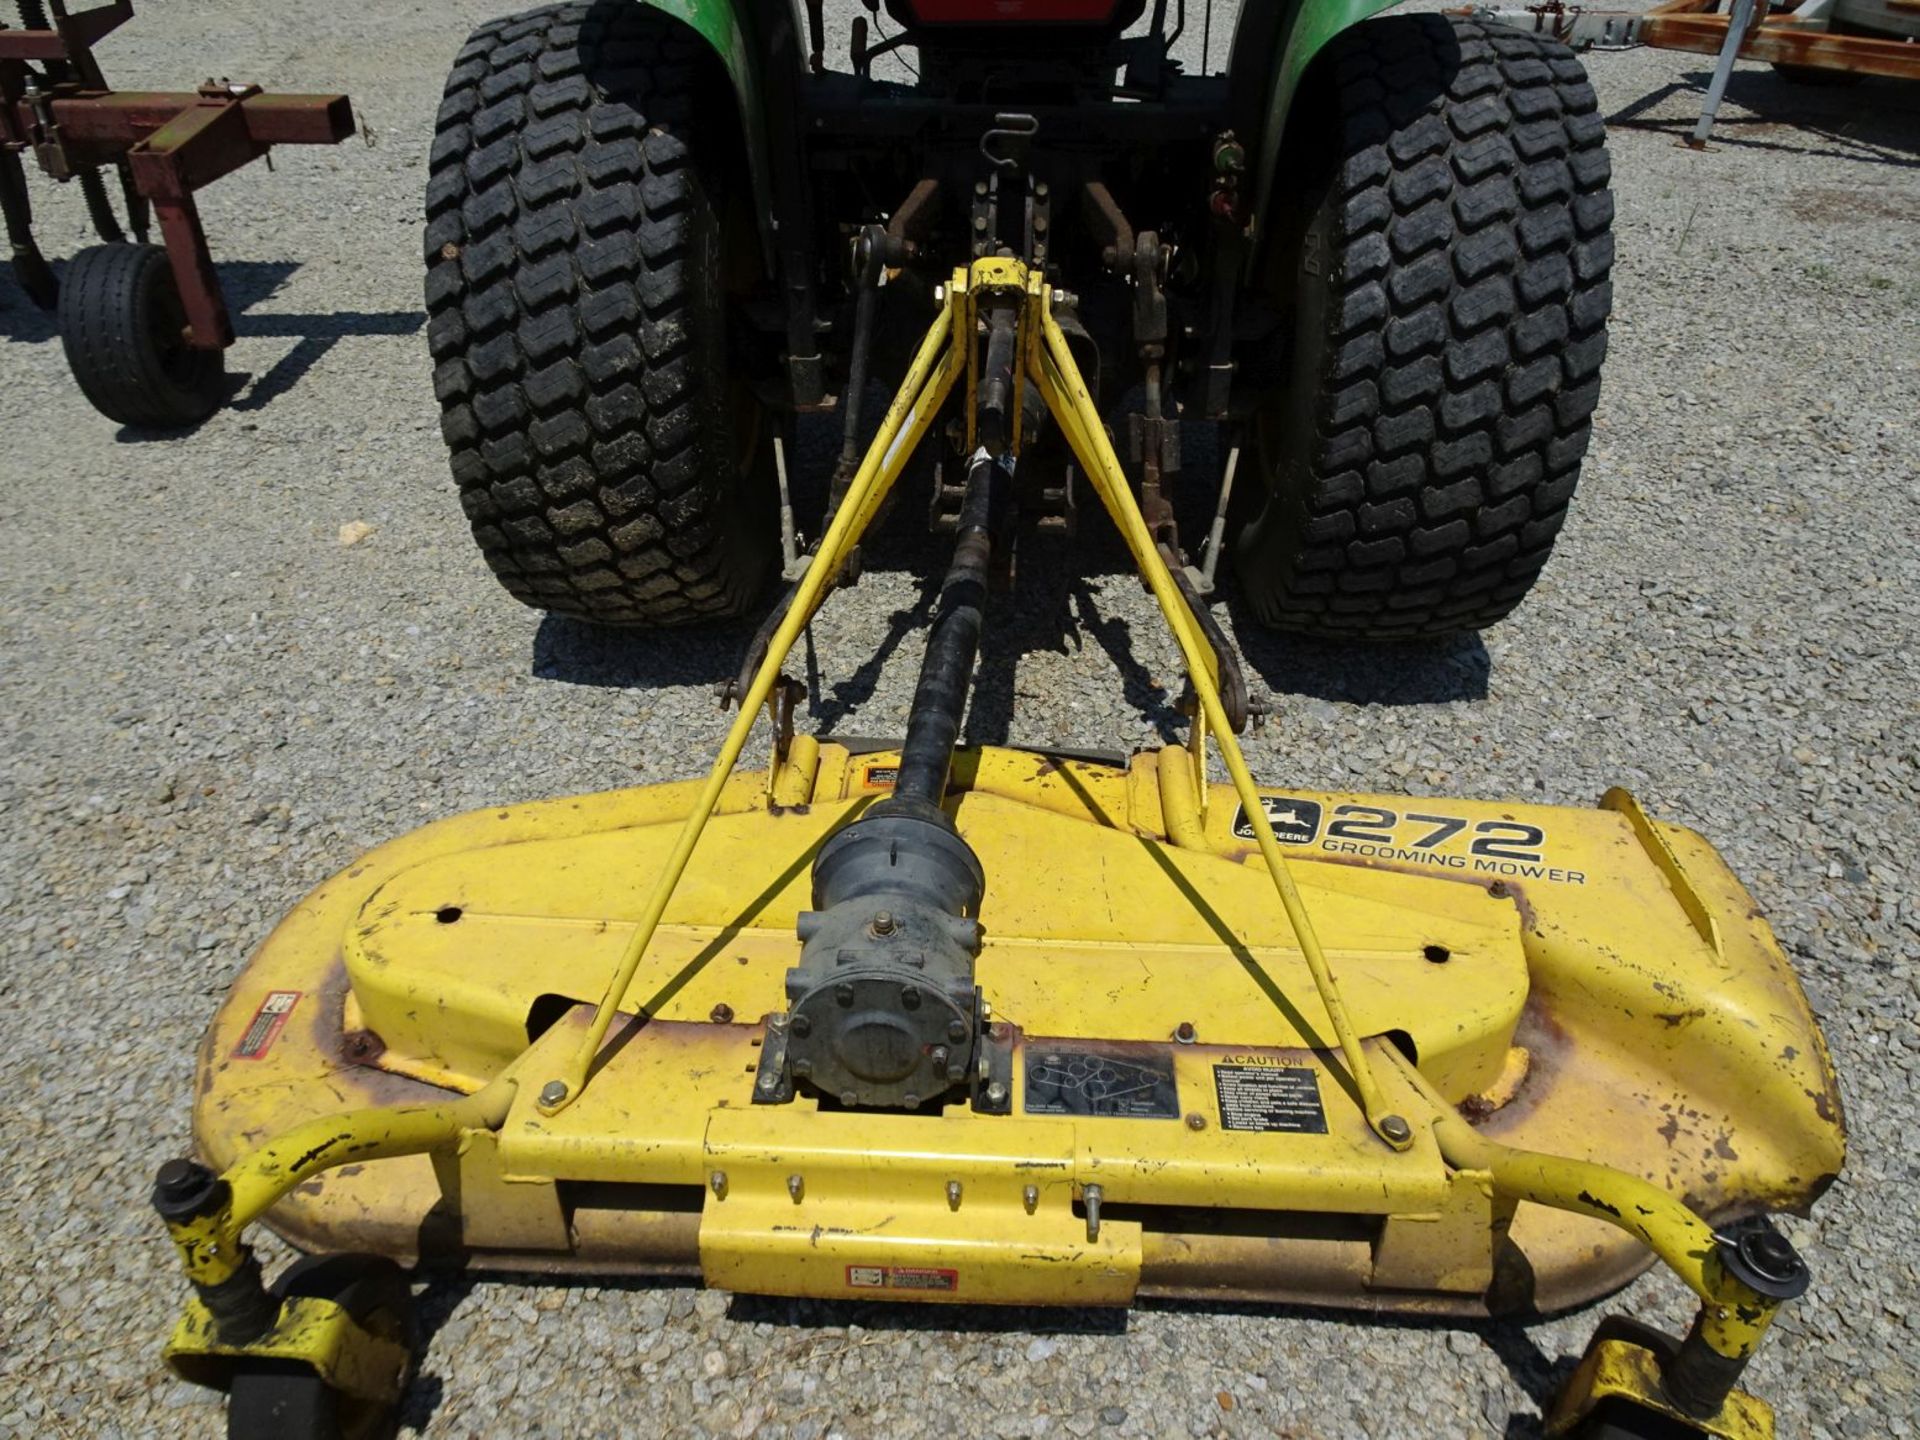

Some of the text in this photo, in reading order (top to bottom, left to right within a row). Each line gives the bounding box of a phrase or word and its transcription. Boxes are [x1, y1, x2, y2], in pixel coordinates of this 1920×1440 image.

[1326, 804, 1544, 863] 272
[1321, 839, 1586, 884] GROOMING MOWER
[1234, 1054, 1304, 1067] CAUTION
